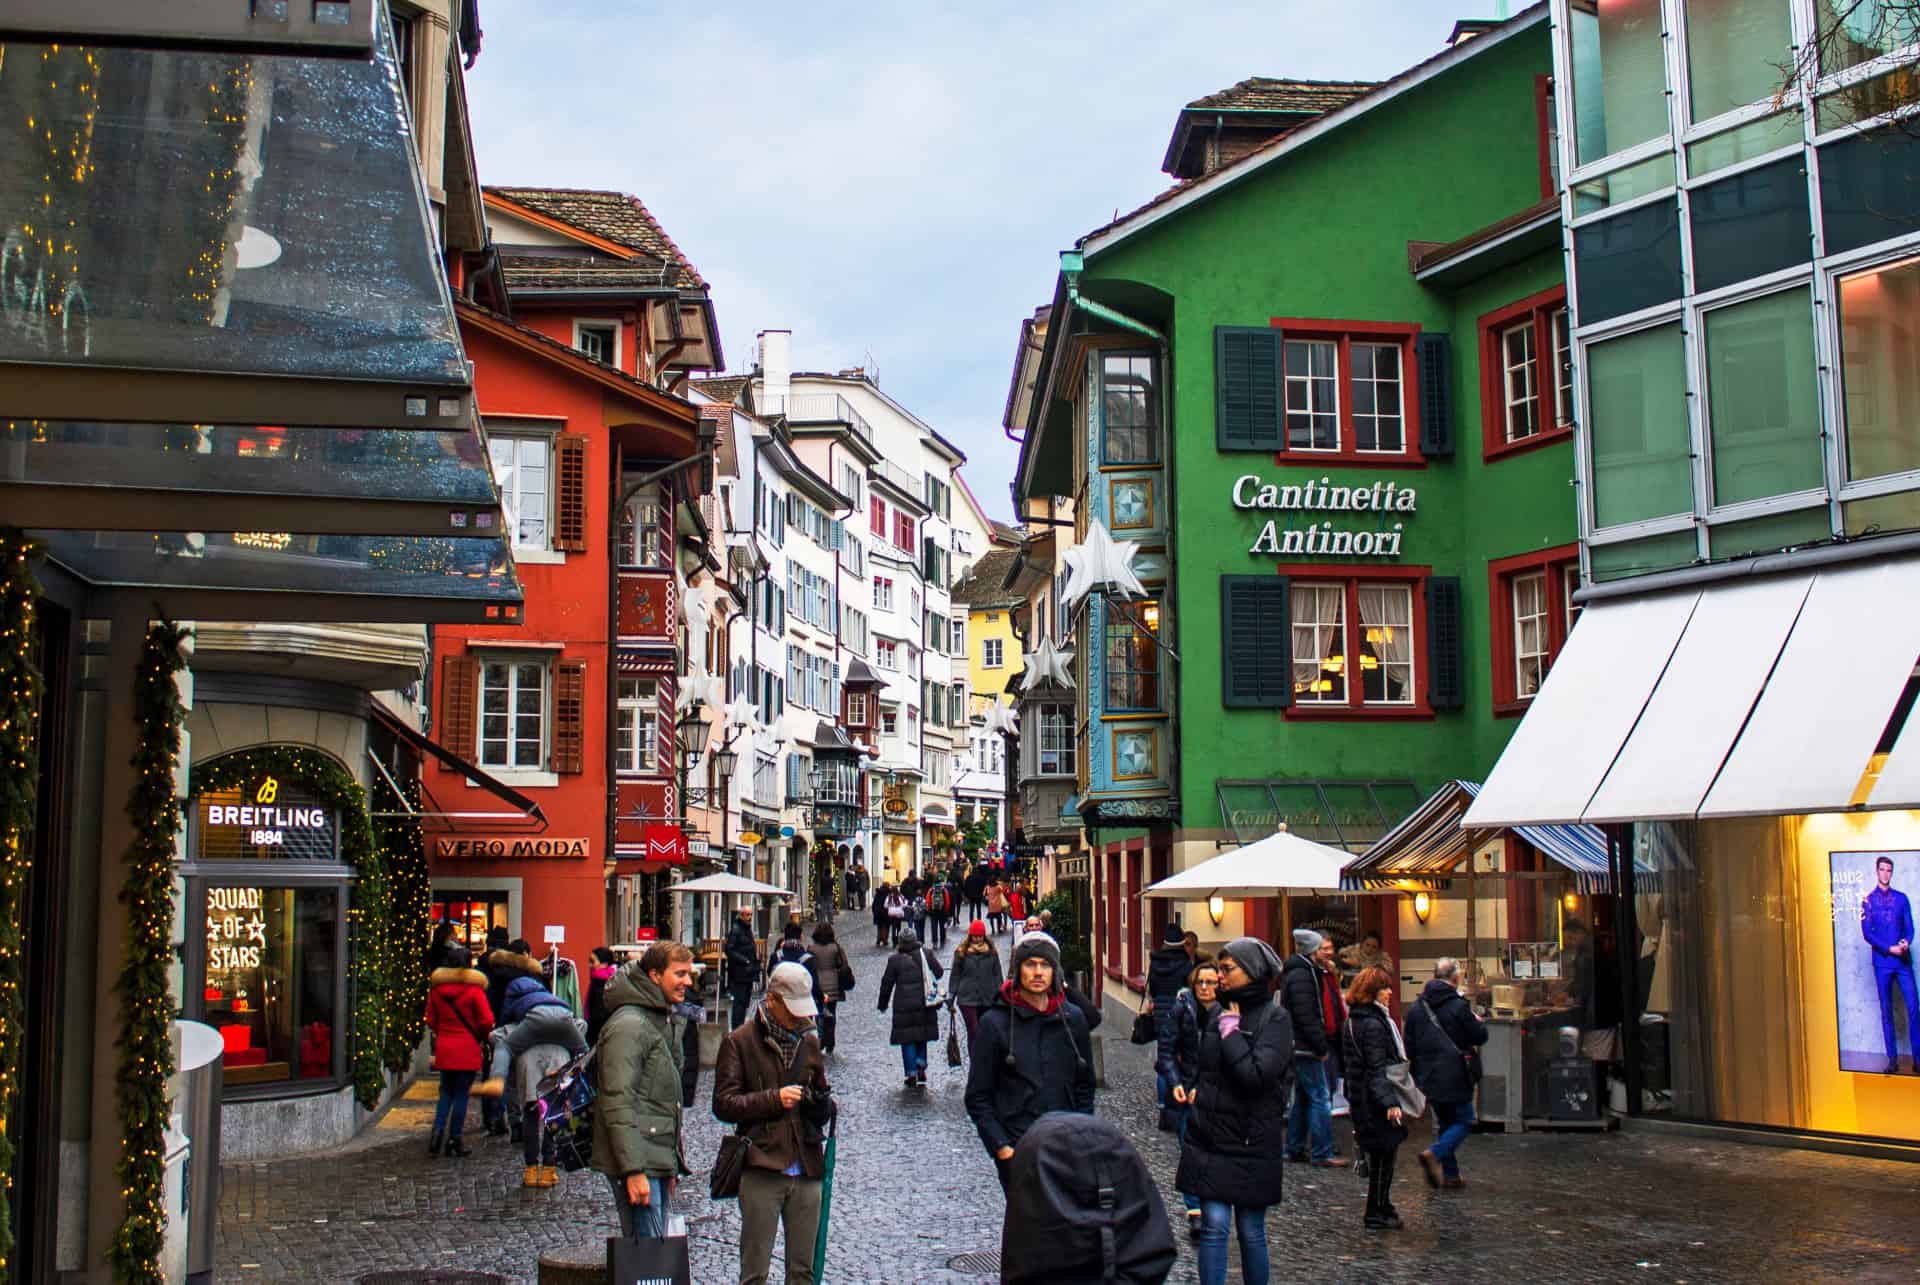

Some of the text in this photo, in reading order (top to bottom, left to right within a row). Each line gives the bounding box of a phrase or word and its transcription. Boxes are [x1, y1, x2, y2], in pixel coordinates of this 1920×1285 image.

[1232, 474, 1417, 512] Cantinetta
[1249, 519, 1403, 555] Antinori
[208, 805, 325, 828] BREITLING
[251, 830, 283, 845] 1884
[441, 840, 585, 856] VERO MODA
[207, 887, 259, 911] SQUAD
[223, 917, 245, 939] OF
[210, 946, 260, 969] STARS
